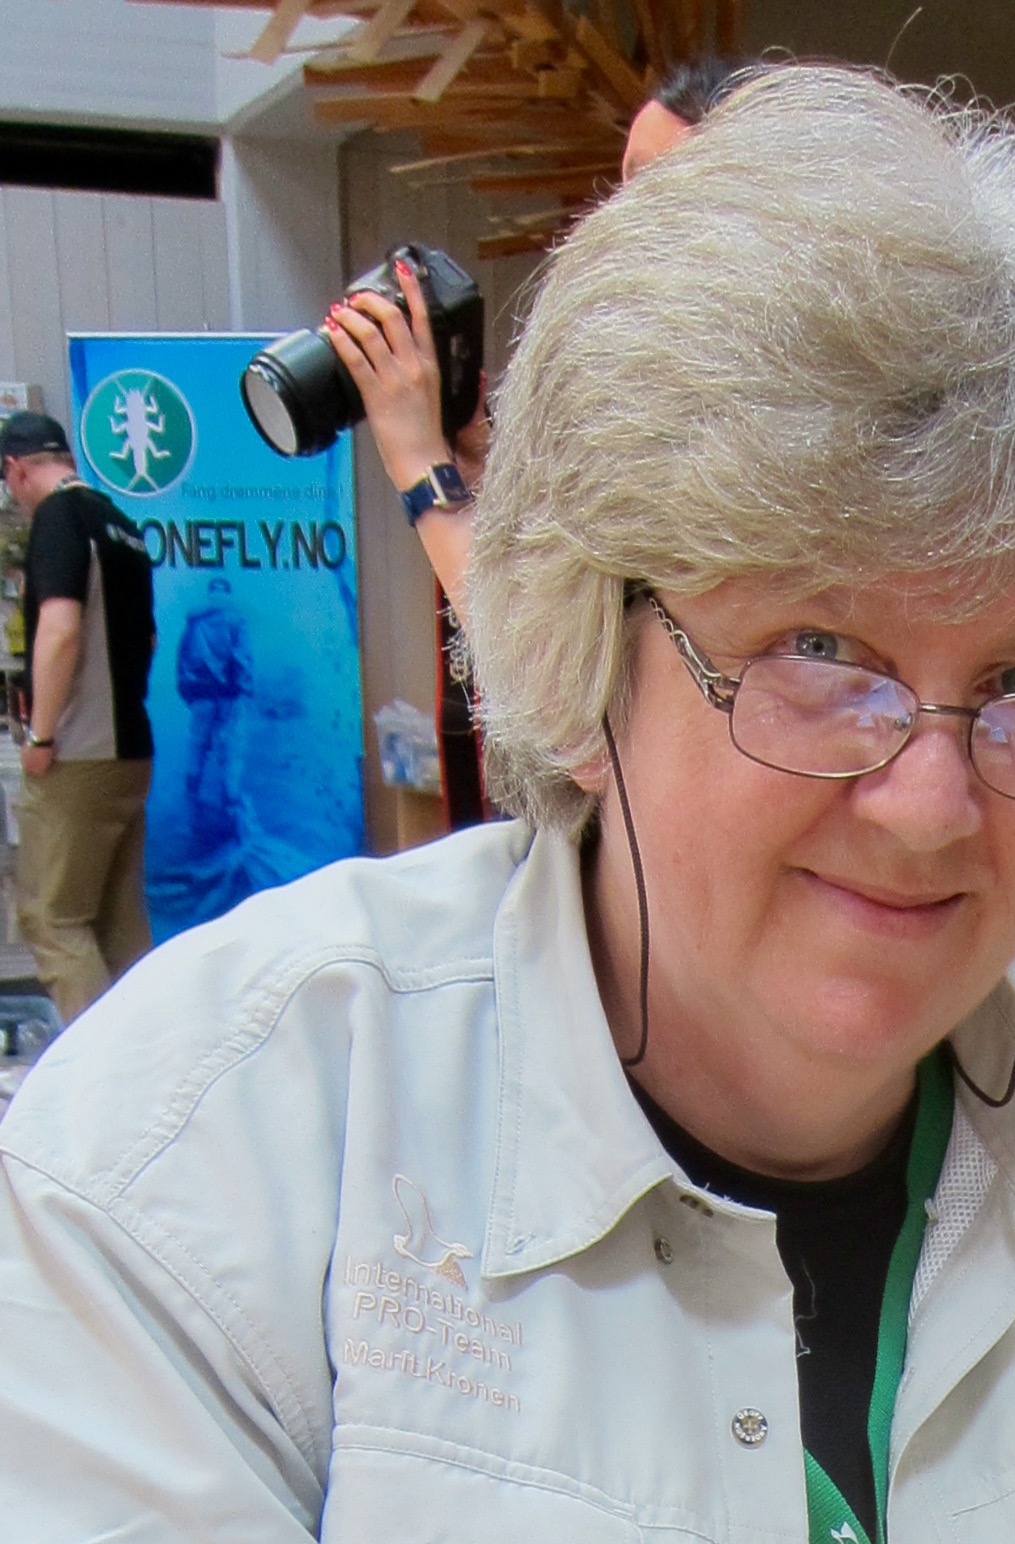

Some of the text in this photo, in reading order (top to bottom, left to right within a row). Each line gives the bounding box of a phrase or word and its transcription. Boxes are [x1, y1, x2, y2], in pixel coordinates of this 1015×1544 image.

[138, 518, 346, 569] ONEFLY.NO
[344, 1256, 523, 1345] International
[352, 1292, 513, 1372] PRO-Team
